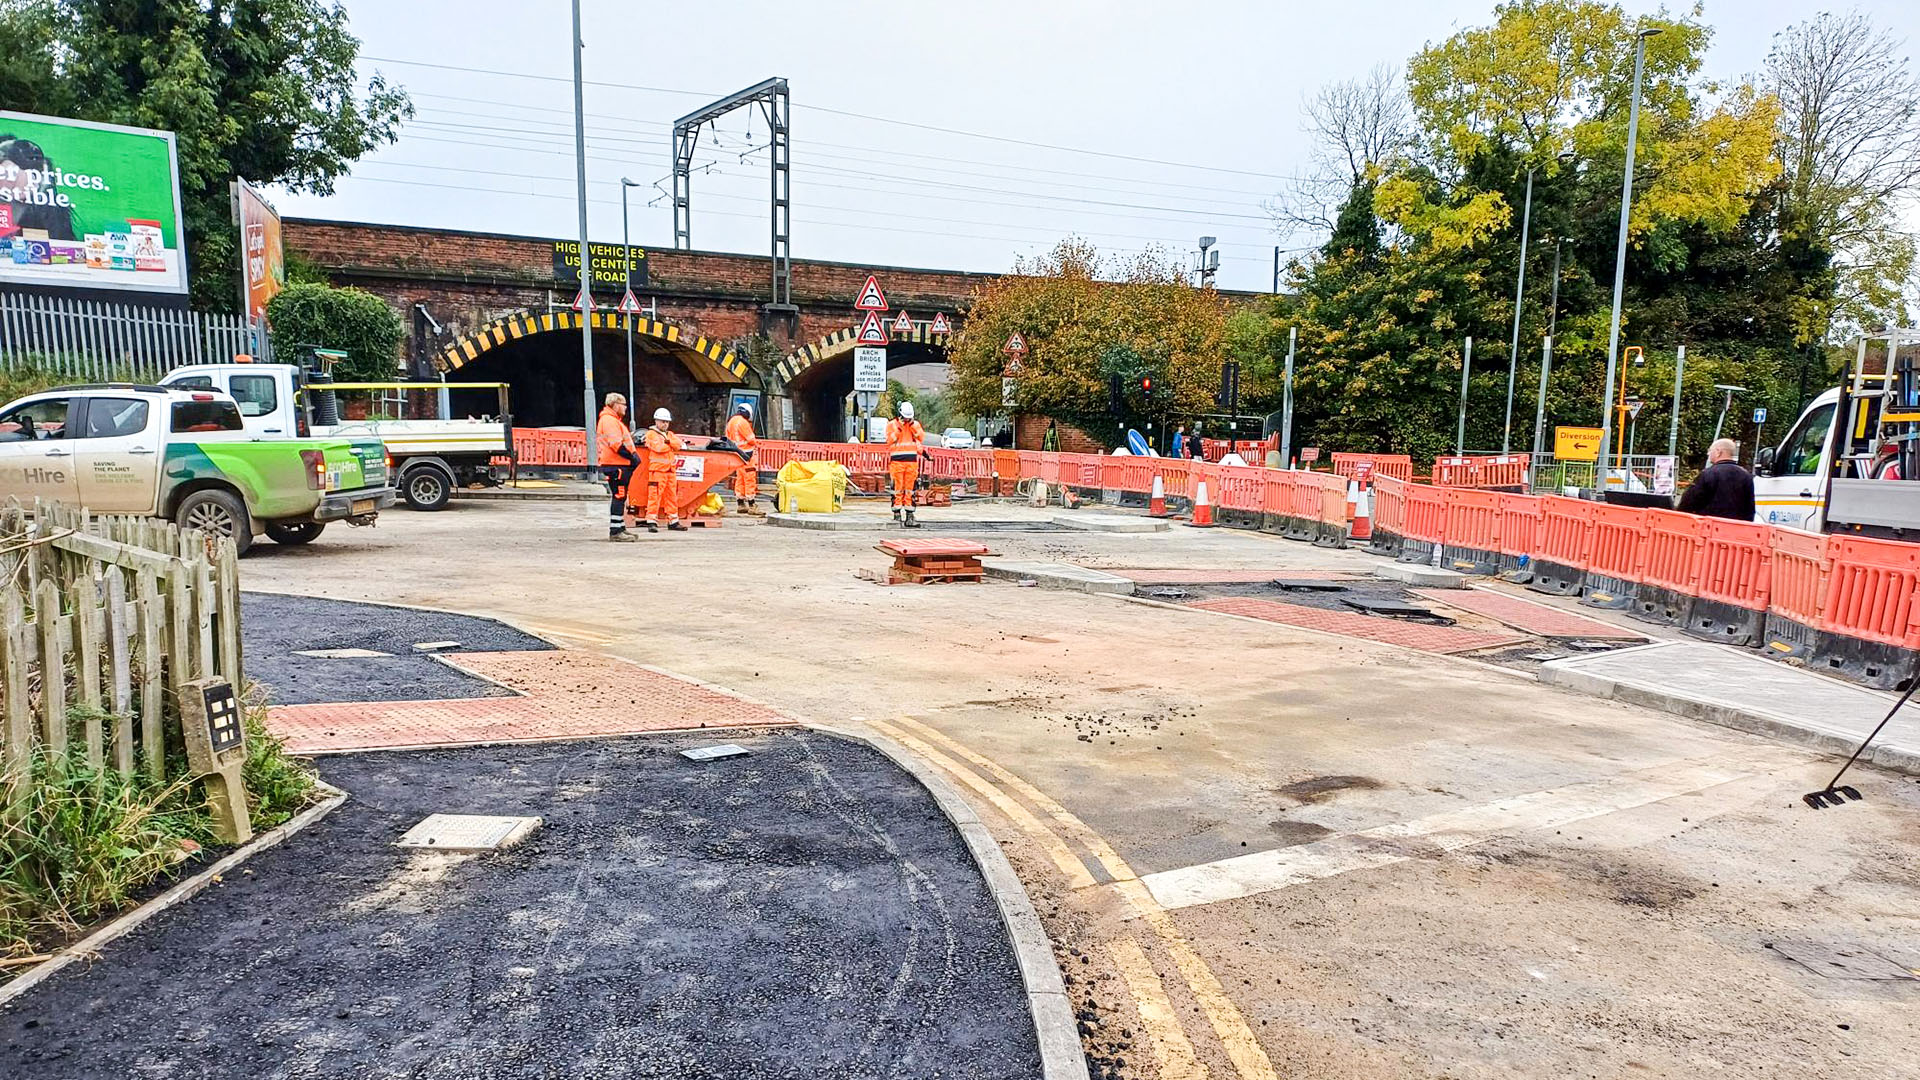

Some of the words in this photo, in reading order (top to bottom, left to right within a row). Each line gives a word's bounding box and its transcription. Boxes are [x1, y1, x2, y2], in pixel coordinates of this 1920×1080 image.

[25, 166, 110, 192] prices.
[0, 186, 76, 209] stible.
[589, 244, 645, 259] VEHICES
[565, 255, 582, 267] US
[595, 271, 627, 282] ROAD
[1560, 431, 1601, 441] Diversion
